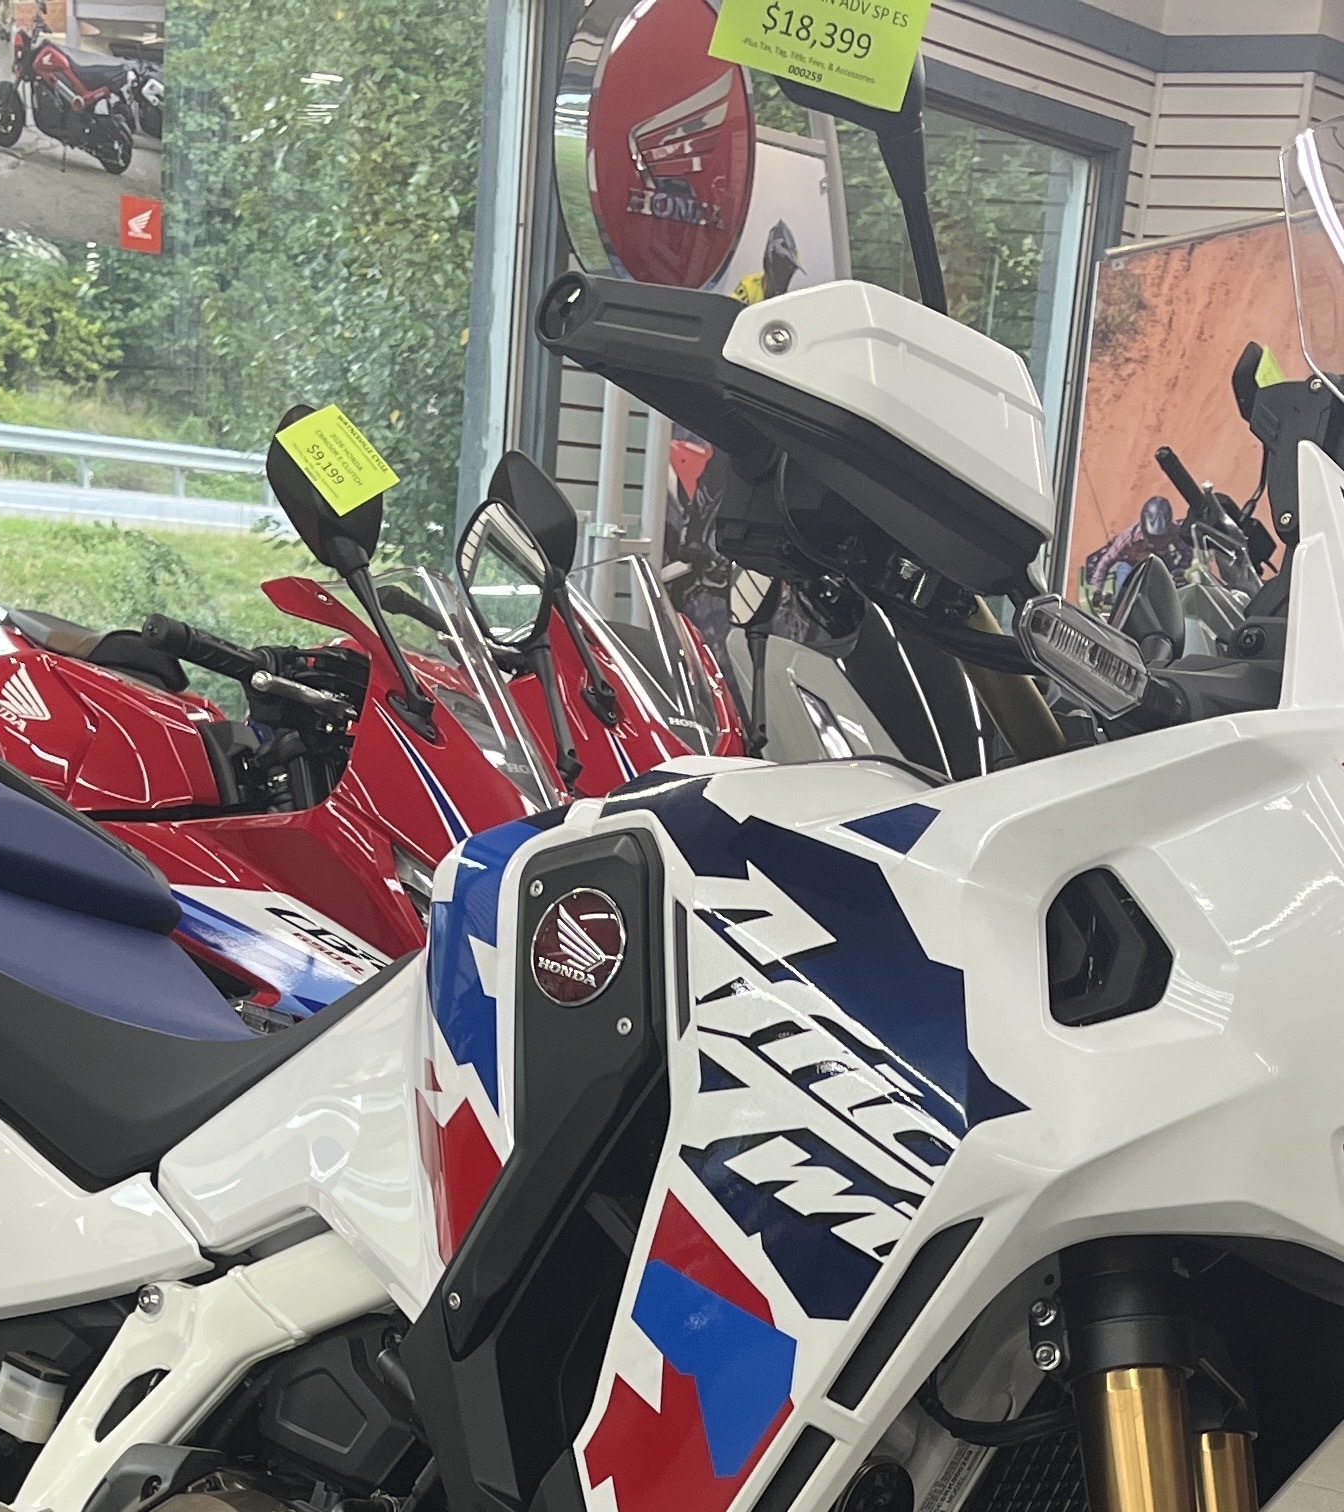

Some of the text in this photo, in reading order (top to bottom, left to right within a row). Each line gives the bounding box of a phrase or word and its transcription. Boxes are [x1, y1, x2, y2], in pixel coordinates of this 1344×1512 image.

[762, 1, 873, 59] $18,399
[872, 5, 890, 20] SP
[893, 11, 910, 28] ES
[787, 64, 824, 83] 000259
[306, 443, 346, 486] $9,199
[537, 956, 597, 989] HONDA
